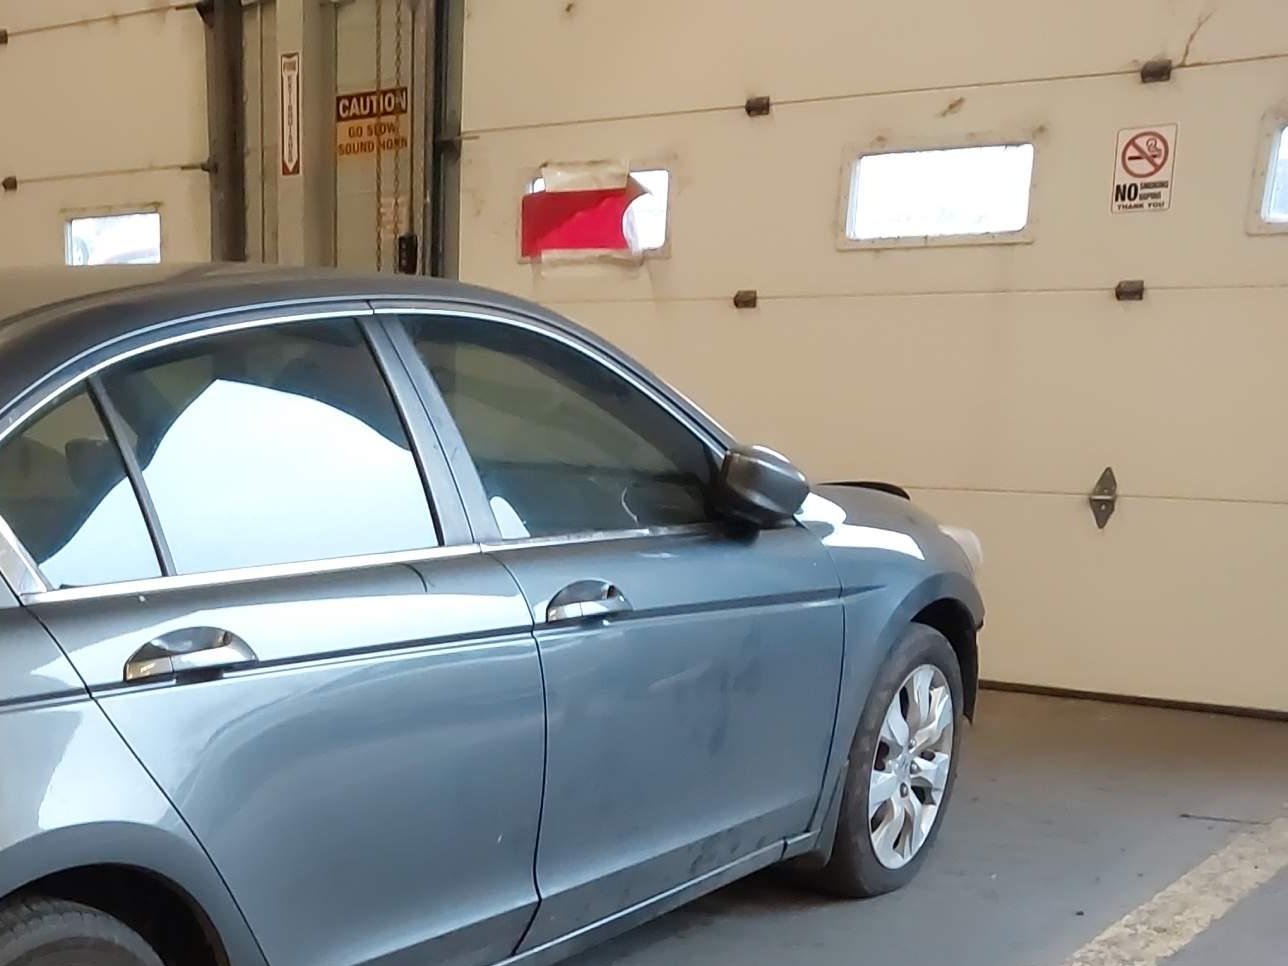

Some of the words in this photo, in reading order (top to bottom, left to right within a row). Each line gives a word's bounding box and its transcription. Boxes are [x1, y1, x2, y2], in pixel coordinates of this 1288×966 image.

[339, 90, 407, 118] CAUTION
[348, 126, 362, 138] GO
[338, 140, 374, 155] SOUND
[1115, 182, 1139, 202] NO
